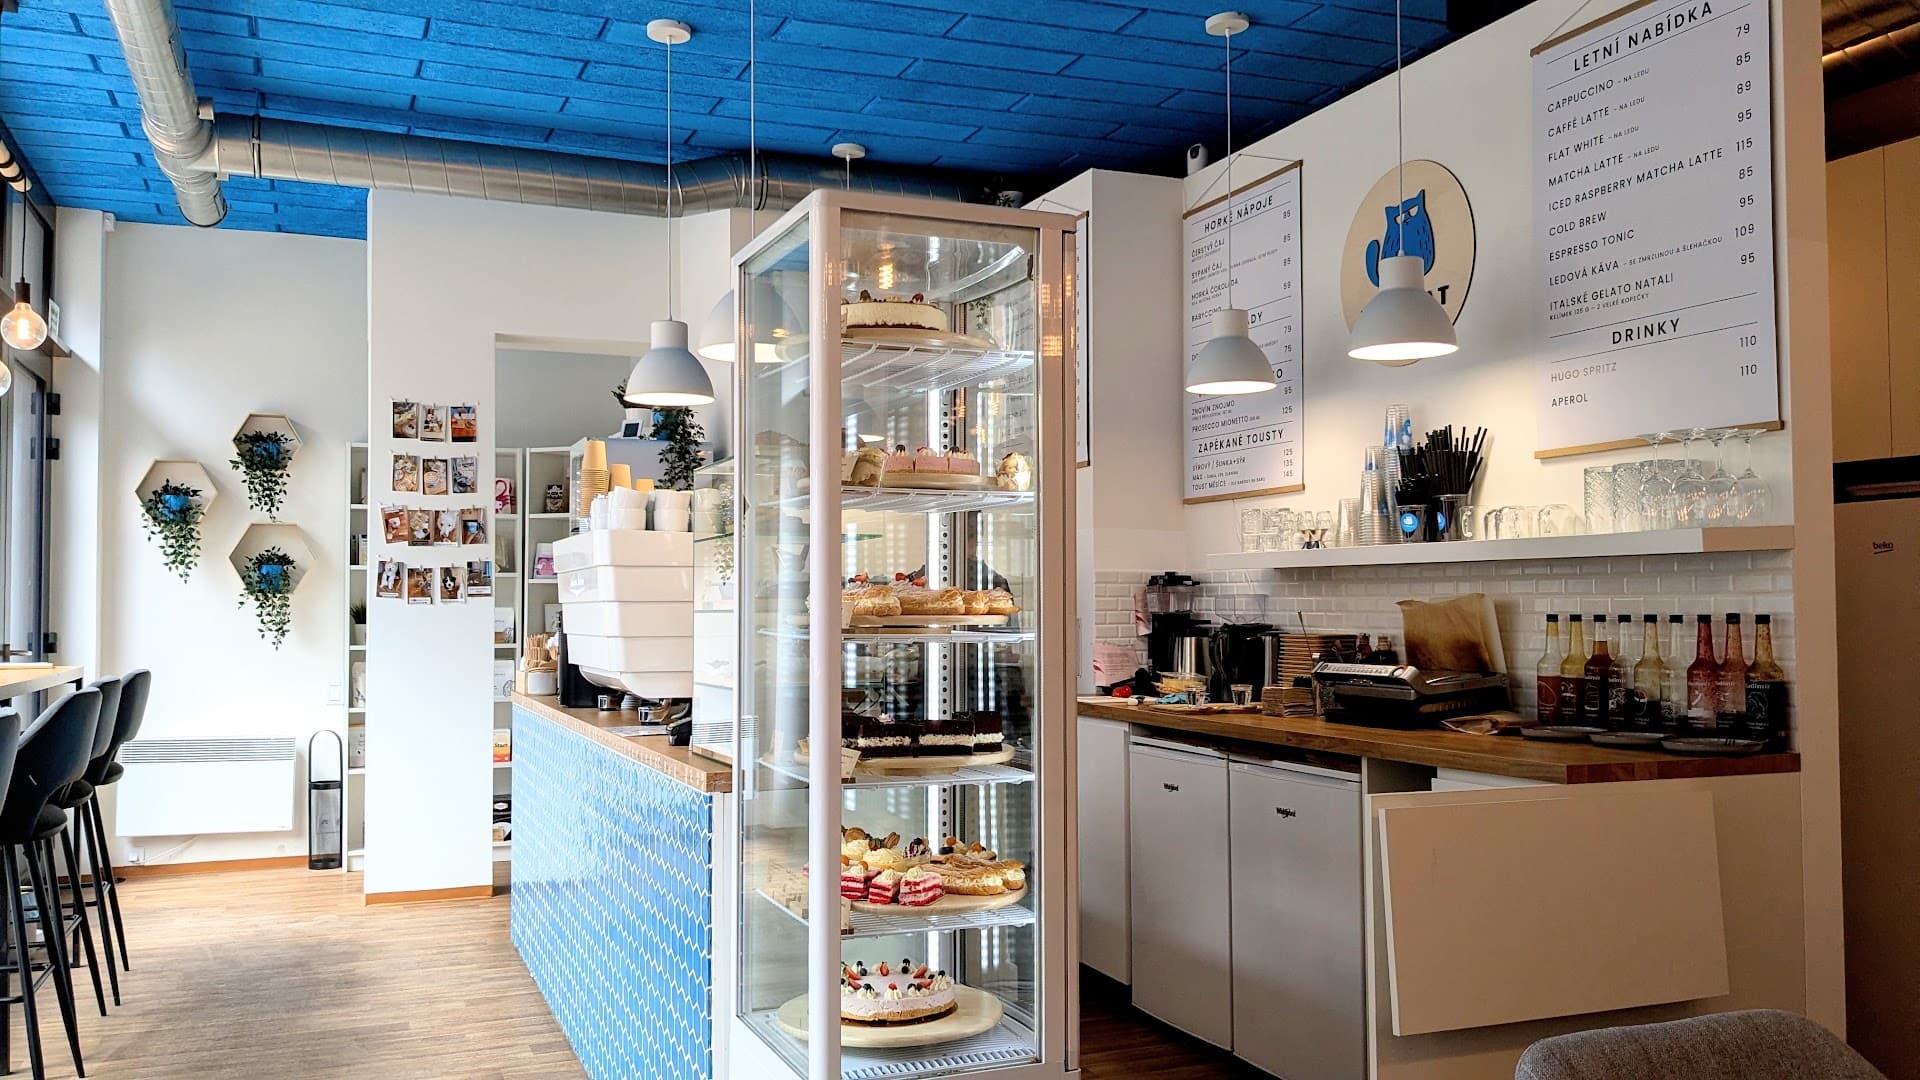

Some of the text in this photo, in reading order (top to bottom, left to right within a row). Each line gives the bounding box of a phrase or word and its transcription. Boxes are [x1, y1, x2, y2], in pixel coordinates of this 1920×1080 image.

[1547, 79, 1614, 113] CAPPUCCINO
[1634, 67, 1649, 78] LEDU
[1736, 24, 1750, 37] 79
[1574, 2, 1712, 71] LETNÍ NABÍDKA
[1581, 106, 1609, 125] LATTE
[1629, 96, 1645, 106] LEDU
[1736, 52, 1751, 66] 85
[1548, 147, 1570, 163] FLAT
[1574, 134, 1604, 153] WHITE
[1624, 126, 1639, 135] LEDU
[1737, 81, 1751, 94] 89
[1548, 165, 1590, 188] MATCHA
[1594, 153, 1623, 171] LATTE
[1644, 144, 1660, 155] LEDU
[1737, 108, 1752, 122] 95
[1548, 137, 1753, 211] ICED RASPBERRY MATCHA LATTE 115
[1549, 166, 1753, 236] COLD BREW 85
[1237, 195, 1273, 219] NÁPOJE
[1549, 194, 1754, 262] ESPRESSO TONIC 95
[1549, 266, 1588, 286] LEDOVÁ
[1591, 260, 1619, 275] KÁVA
[1735, 224, 1754, 238] 109
[1550, 252, 1755, 311] ITALSKÉ GELATO NATALI 95
[1551, 335, 1758, 383] HUGO SPRITZ 110
[1612, 318, 1680, 344] DRINKY
[1282, 406, 1293, 415] 125
[1551, 364, 1758, 407] APEROL 110
[1198, 428, 1284, 453] ZAPÉKANÉ TOUSTY
